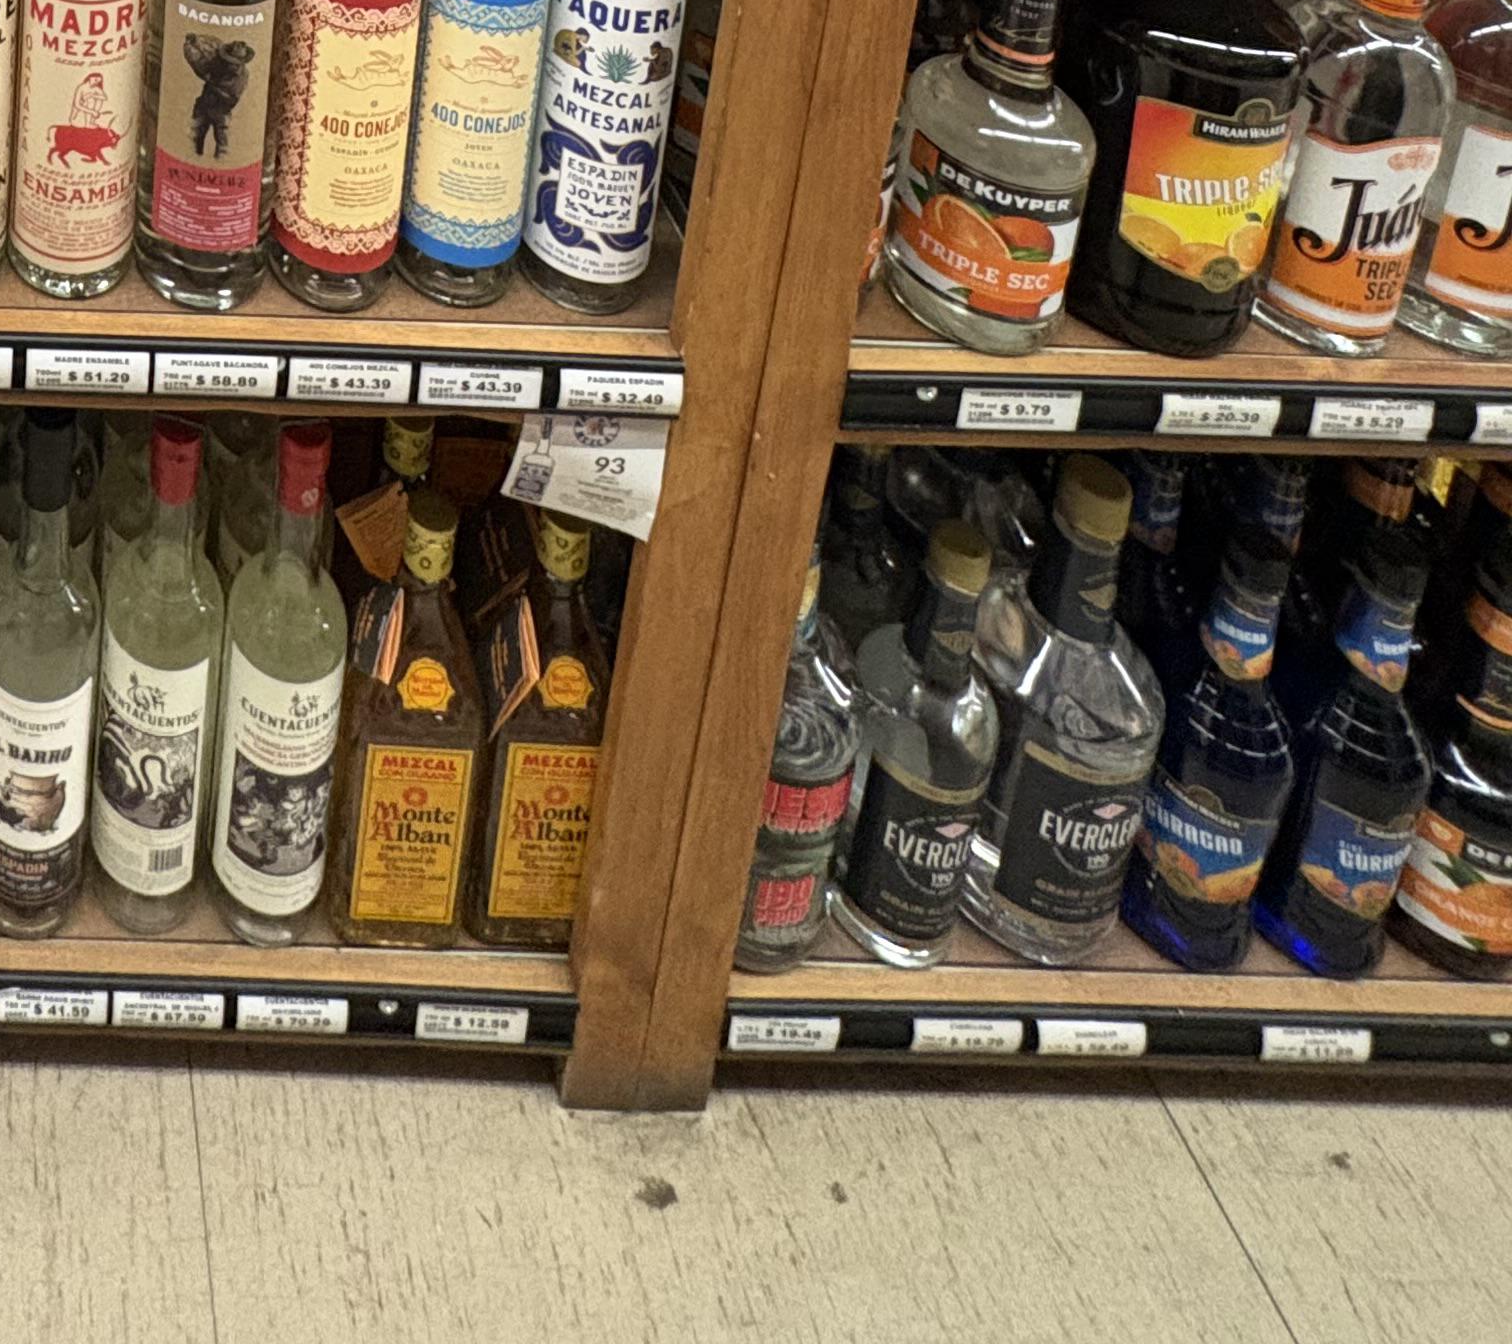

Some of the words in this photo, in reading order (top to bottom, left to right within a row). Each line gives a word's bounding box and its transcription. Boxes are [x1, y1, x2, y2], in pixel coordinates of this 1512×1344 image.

[177, 3, 265, 26] BACANORA
[42, 26, 139, 58] MEZCAL
[571, 80, 653, 110] MEZCAL
[320, 114, 351, 137] 400
[431, 103, 460, 129] 400
[463, 114, 527, 133] CONEJOS
[552, 94, 662, 135] ARTESANAL
[566, 183, 632, 207] JOVEN
[940, 162, 970, 192] DE
[975, 174, 1070, 213] KUYPER
[1155, 173, 1249, 205] TRIPLE
[918, 231, 999, 283] TRIPLE
[1005, 269, 1049, 292] SEC
[594, 454, 626, 475] 93
[7, 740, 73, 765] BARRO
[382, 755, 458, 772] MEZCAL
[371, 799, 456, 825] Monte
[369, 821, 452, 846] Alban
